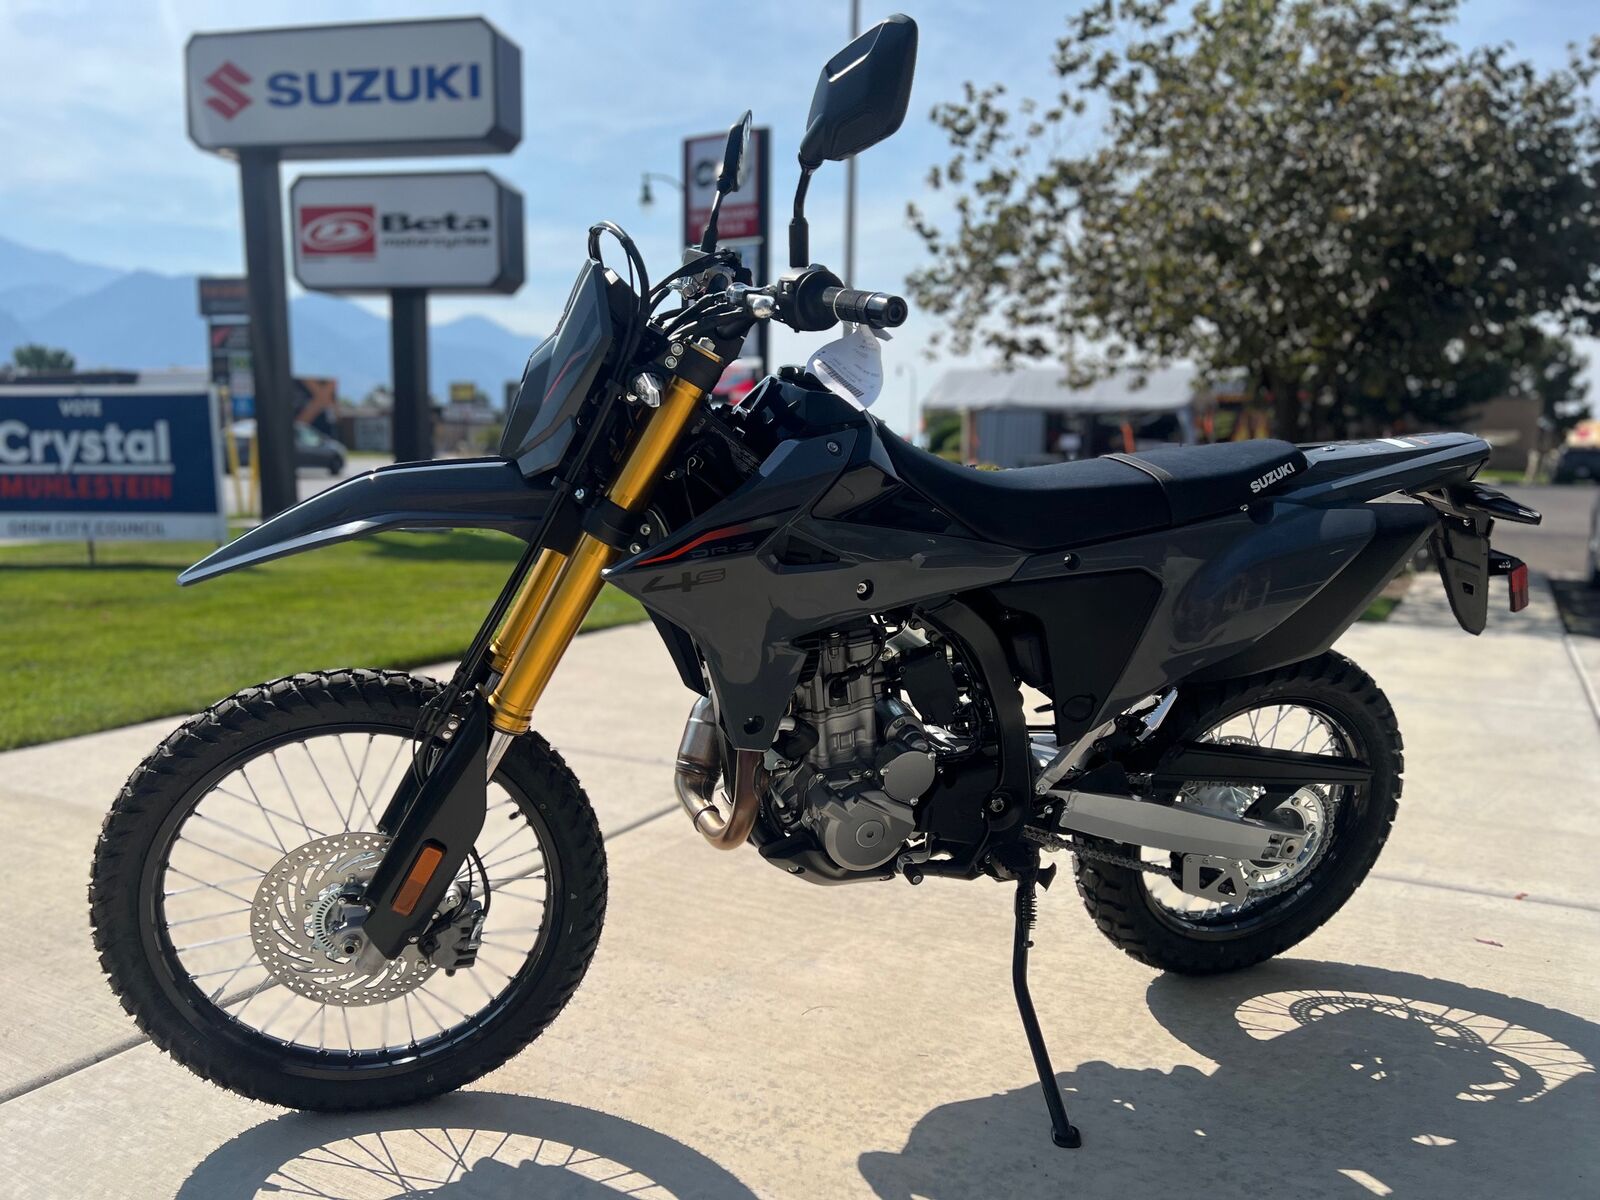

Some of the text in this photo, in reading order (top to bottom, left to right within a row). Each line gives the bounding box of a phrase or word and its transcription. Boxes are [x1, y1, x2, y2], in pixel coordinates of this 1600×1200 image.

[265, 63, 481, 108] SUZUKI
[381, 213, 491, 233] Beta
[58, 399, 102, 417] VOTE
[0, 419, 171, 473] Crystal
[1250, 462, 1295, 494] SUZUKI
[691, 541, 755, 558] DR-Z
